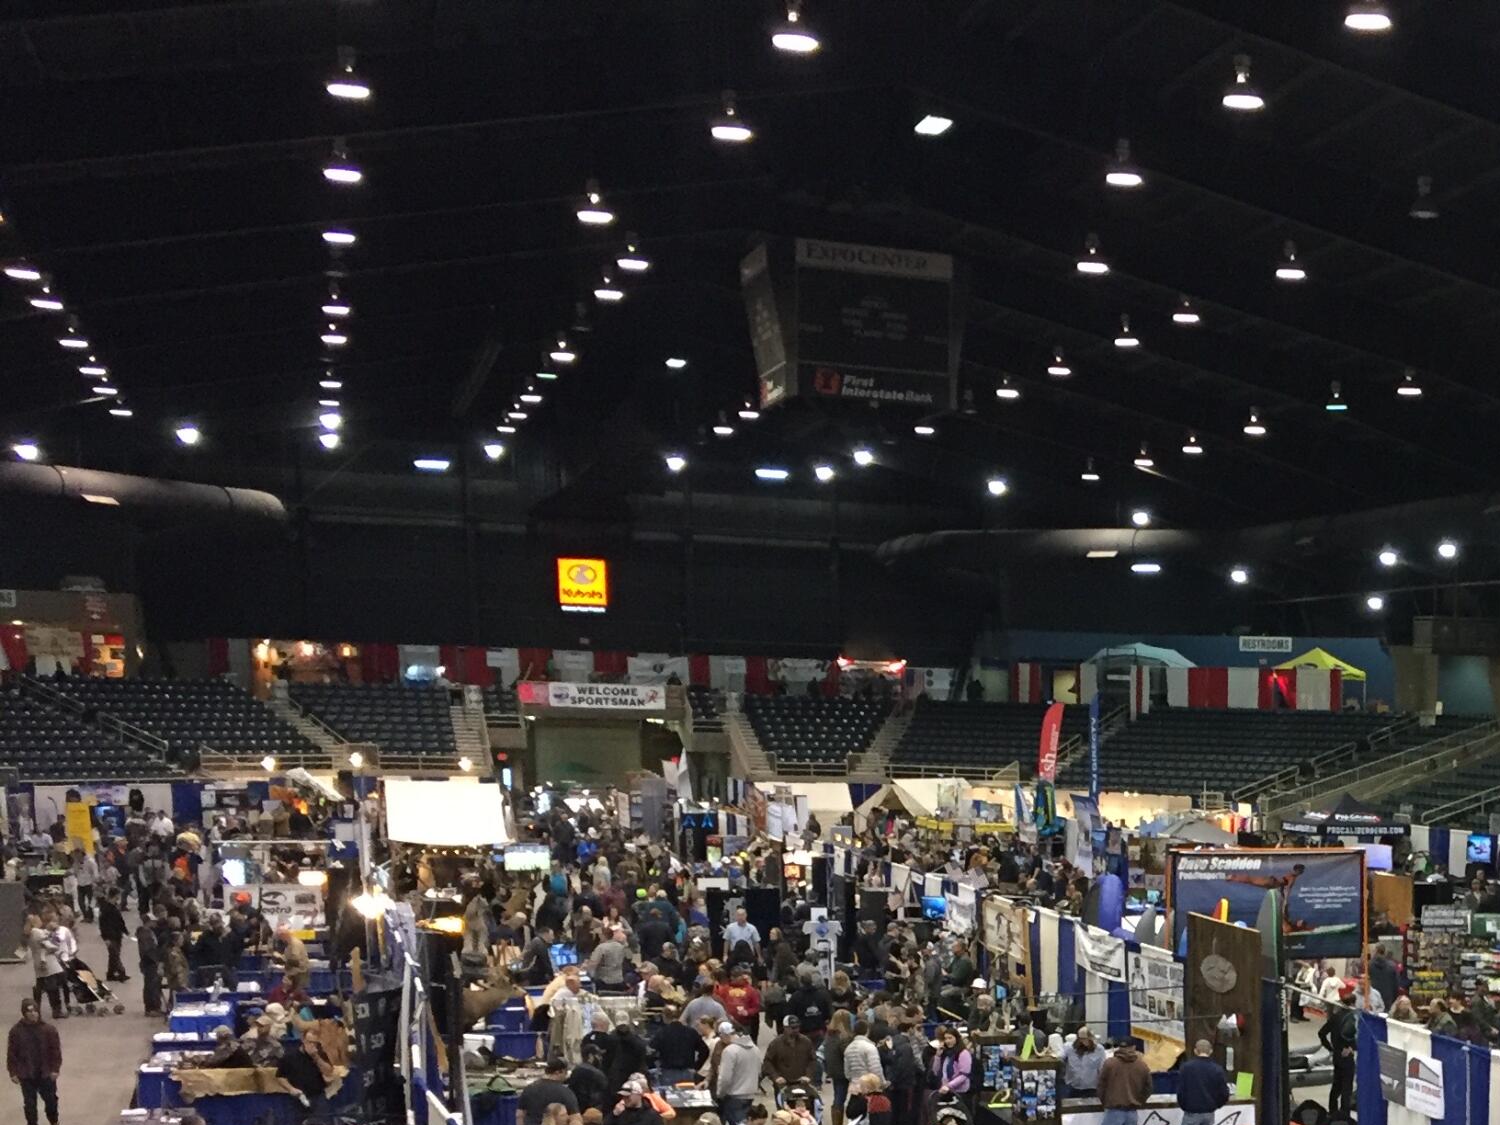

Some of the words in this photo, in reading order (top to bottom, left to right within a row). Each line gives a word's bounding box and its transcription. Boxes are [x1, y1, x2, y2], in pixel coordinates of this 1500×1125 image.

[843, 375, 875, 387] First
[562, 588, 603, 600] Kubota
[577, 686, 638, 697] WELCOME
[570, 697, 646, 707] SPORTSMAN
